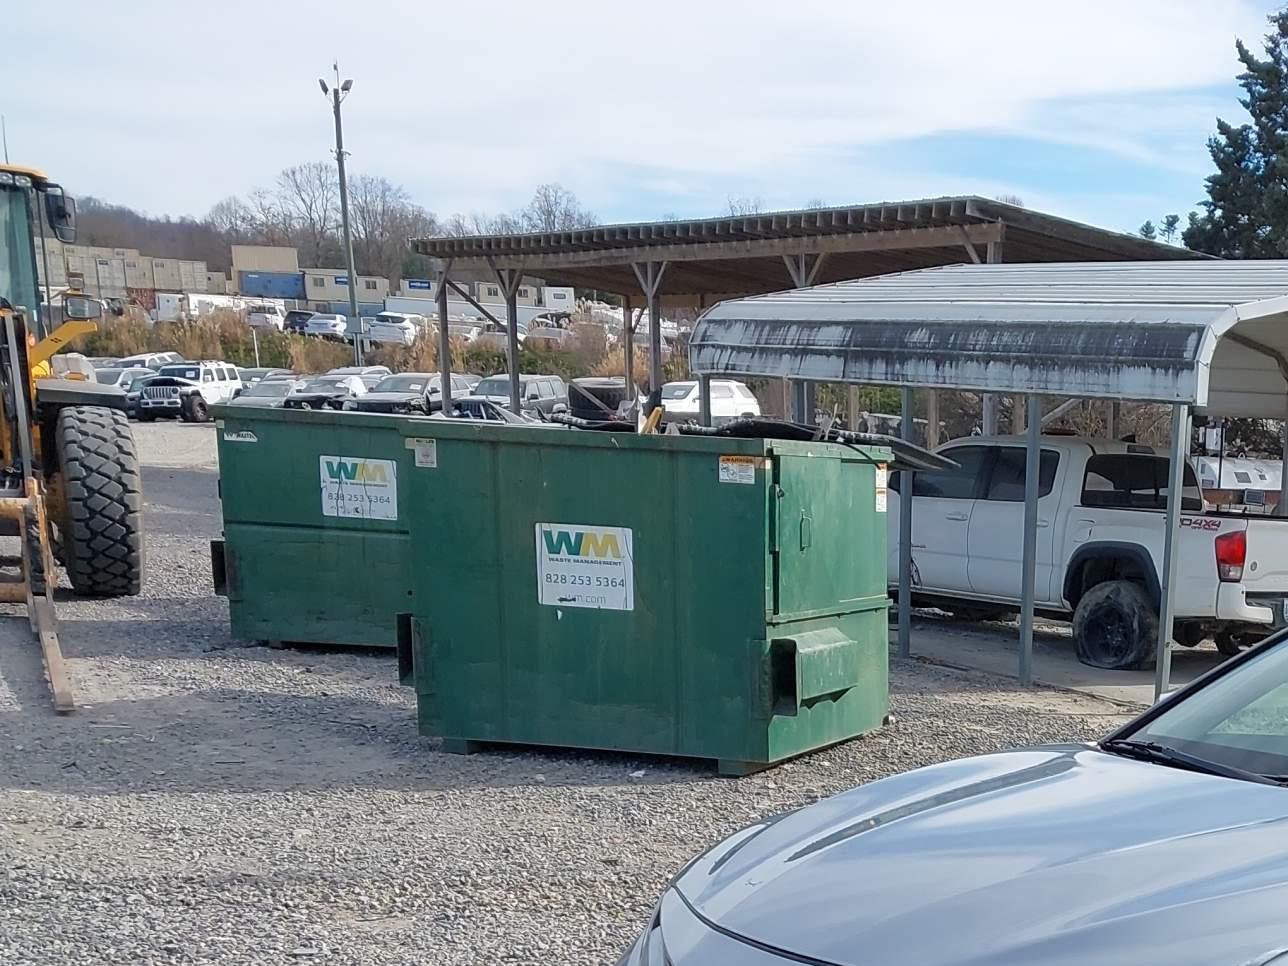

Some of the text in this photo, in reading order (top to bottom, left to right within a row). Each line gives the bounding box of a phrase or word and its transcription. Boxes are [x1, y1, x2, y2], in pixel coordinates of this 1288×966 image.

[326, 461, 386, 481] WM
[346, 494, 364, 503] 253
[543, 530, 621, 558] WM
[573, 559, 622, 567] MANAGEMENT
[545, 573, 625, 588] 828 253 5364
